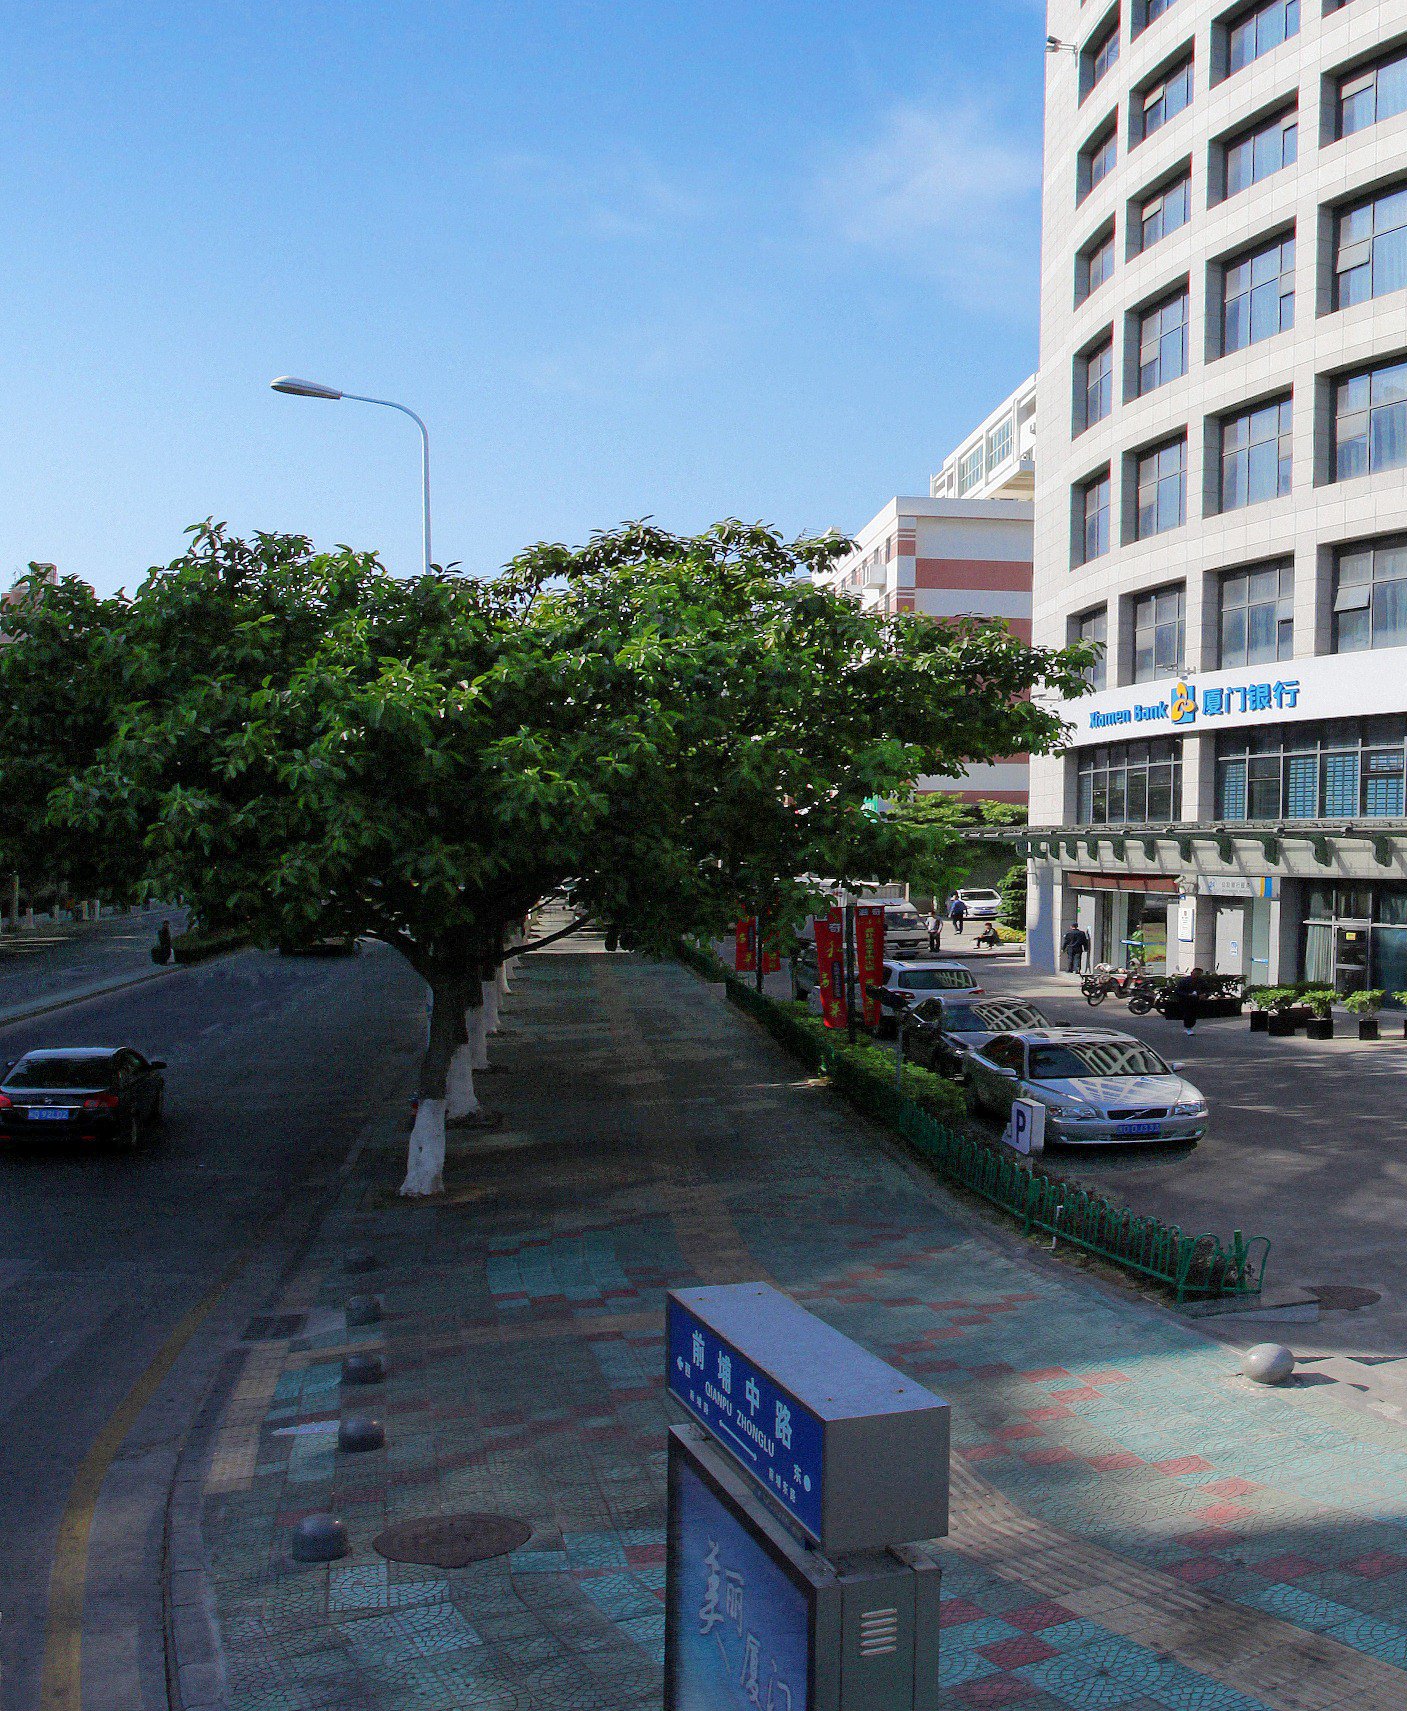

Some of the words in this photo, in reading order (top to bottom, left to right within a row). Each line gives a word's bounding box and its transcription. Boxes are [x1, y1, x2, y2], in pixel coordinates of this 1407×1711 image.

[1089, 709, 1131, 729] Xiamen
[1134, 701, 1168, 721] Bank
[1202, 680, 1300, 717] 厦门银行
[1016, 1109, 1027, 1144] P
[692, 1330, 793, 1450] 前埔中路
[704, 1381, 733, 1417] QIANPU
[736, 1409, 776, 1458] ZHONGLU
